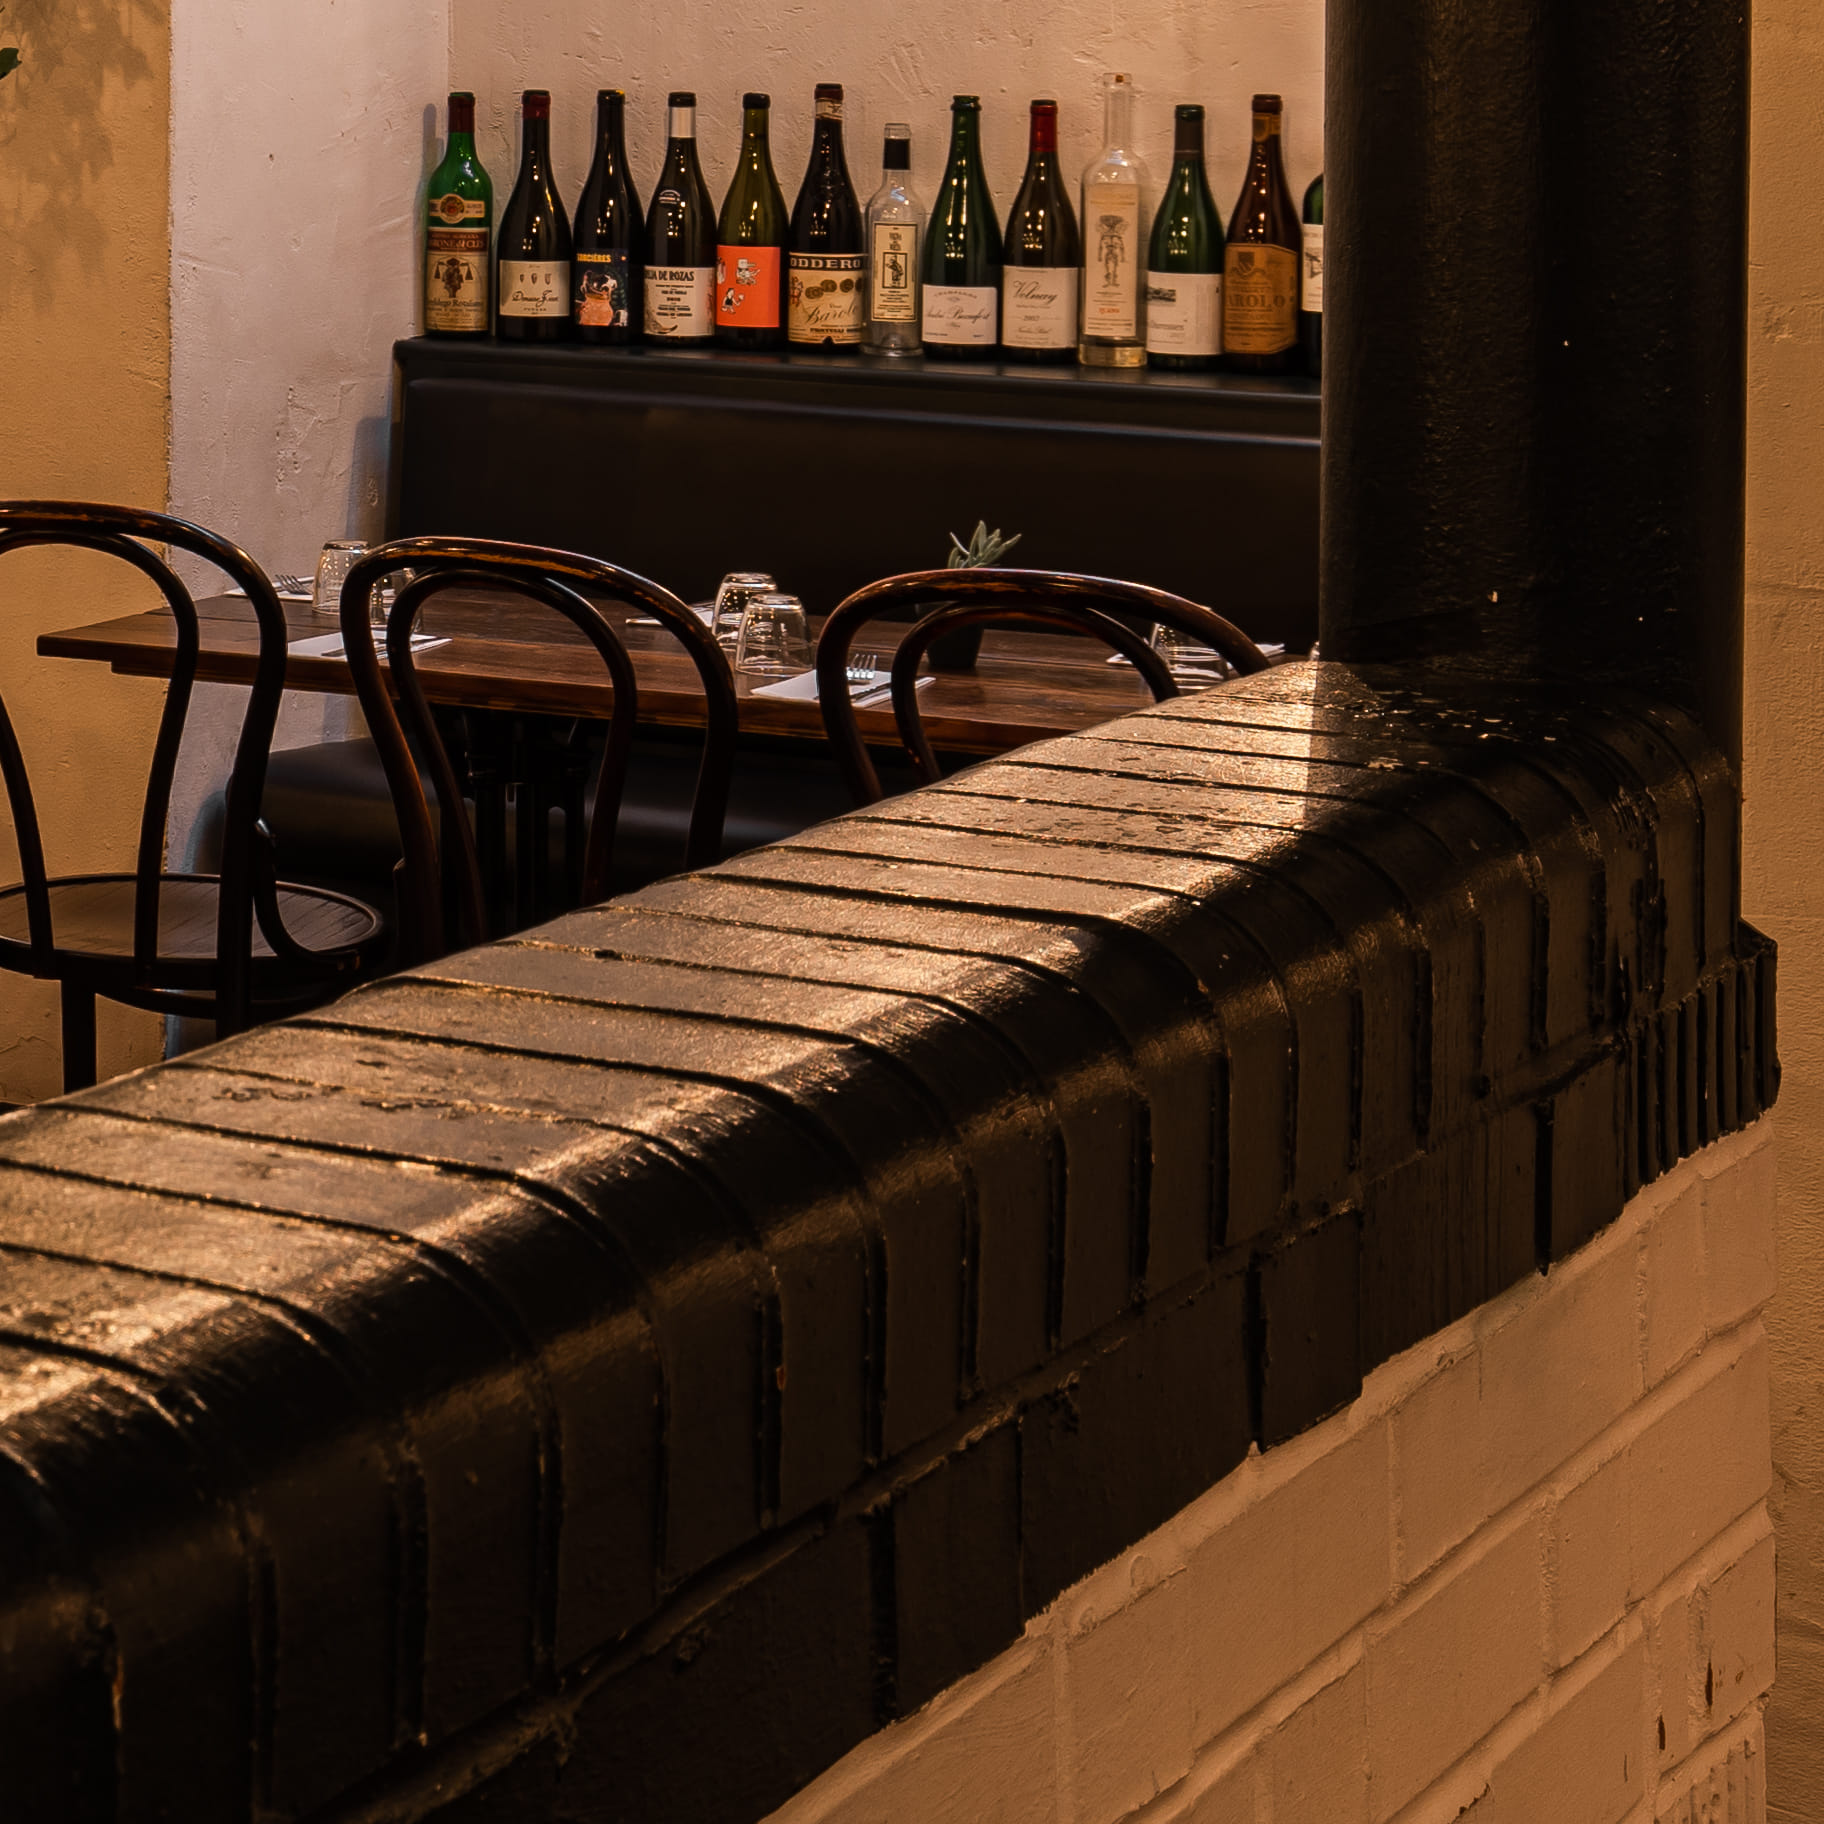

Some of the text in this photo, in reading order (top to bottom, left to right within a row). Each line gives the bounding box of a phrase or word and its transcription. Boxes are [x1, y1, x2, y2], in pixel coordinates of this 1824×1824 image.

[658, 271, 668, 281] DE
[669, 271, 695, 281] ROZAS
[1226, 294, 1286, 307] AROLO
